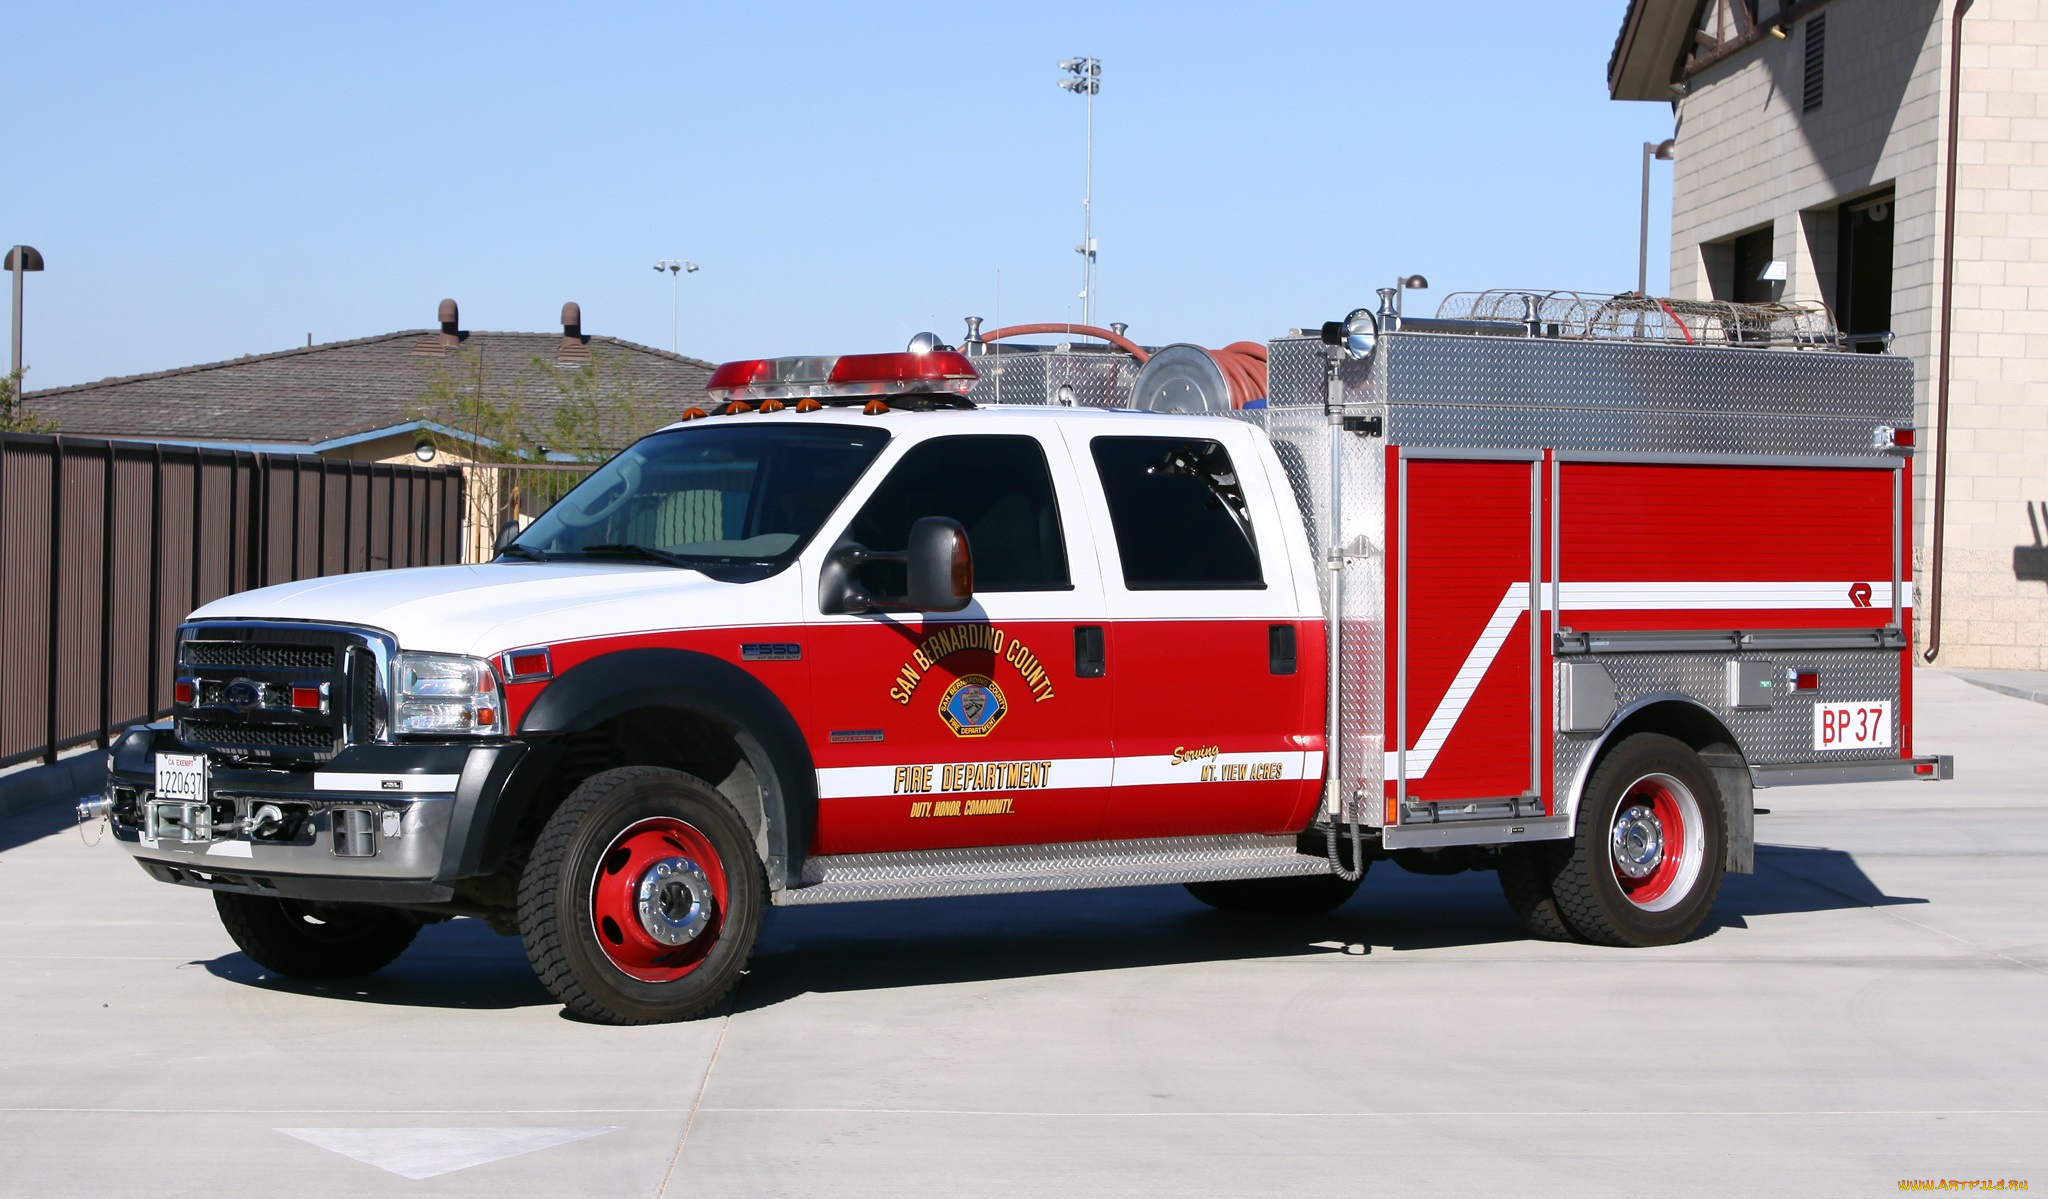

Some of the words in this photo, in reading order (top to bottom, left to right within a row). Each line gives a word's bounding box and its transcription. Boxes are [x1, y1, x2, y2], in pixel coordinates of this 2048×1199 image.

[889, 662, 922, 705] SAN
[912, 623, 1005, 672] BERNARDINO
[1005, 638, 1055, 703] COUNTY
[940, 695, 951, 712] SAN
[949, 676, 989, 696] BERNARDINO
[988, 683, 1006, 710] COUNTY
[948, 717, 961, 731] FIRE
[961, 716, 996, 735] DEPARTMENT
[1822, 708, 1851, 744] BP
[1855, 707, 1883, 743] 37
[167, 758, 175, 766] CA
[175, 759, 194, 767] EXEMPT
[1171, 744, 1220, 766] Serving
[158, 770, 202, 795] 1220637
[893, 765, 934, 794] FIRE
[940, 761, 1052, 792] DEPARTMENT
[1200, 764, 1218, 782] MT.
[1221, 763, 1248, 781] VIEW
[1249, 762, 1284, 780] ACRES
[909, 801, 932, 818] DUTY,
[933, 800, 962, 817] HONOR,
